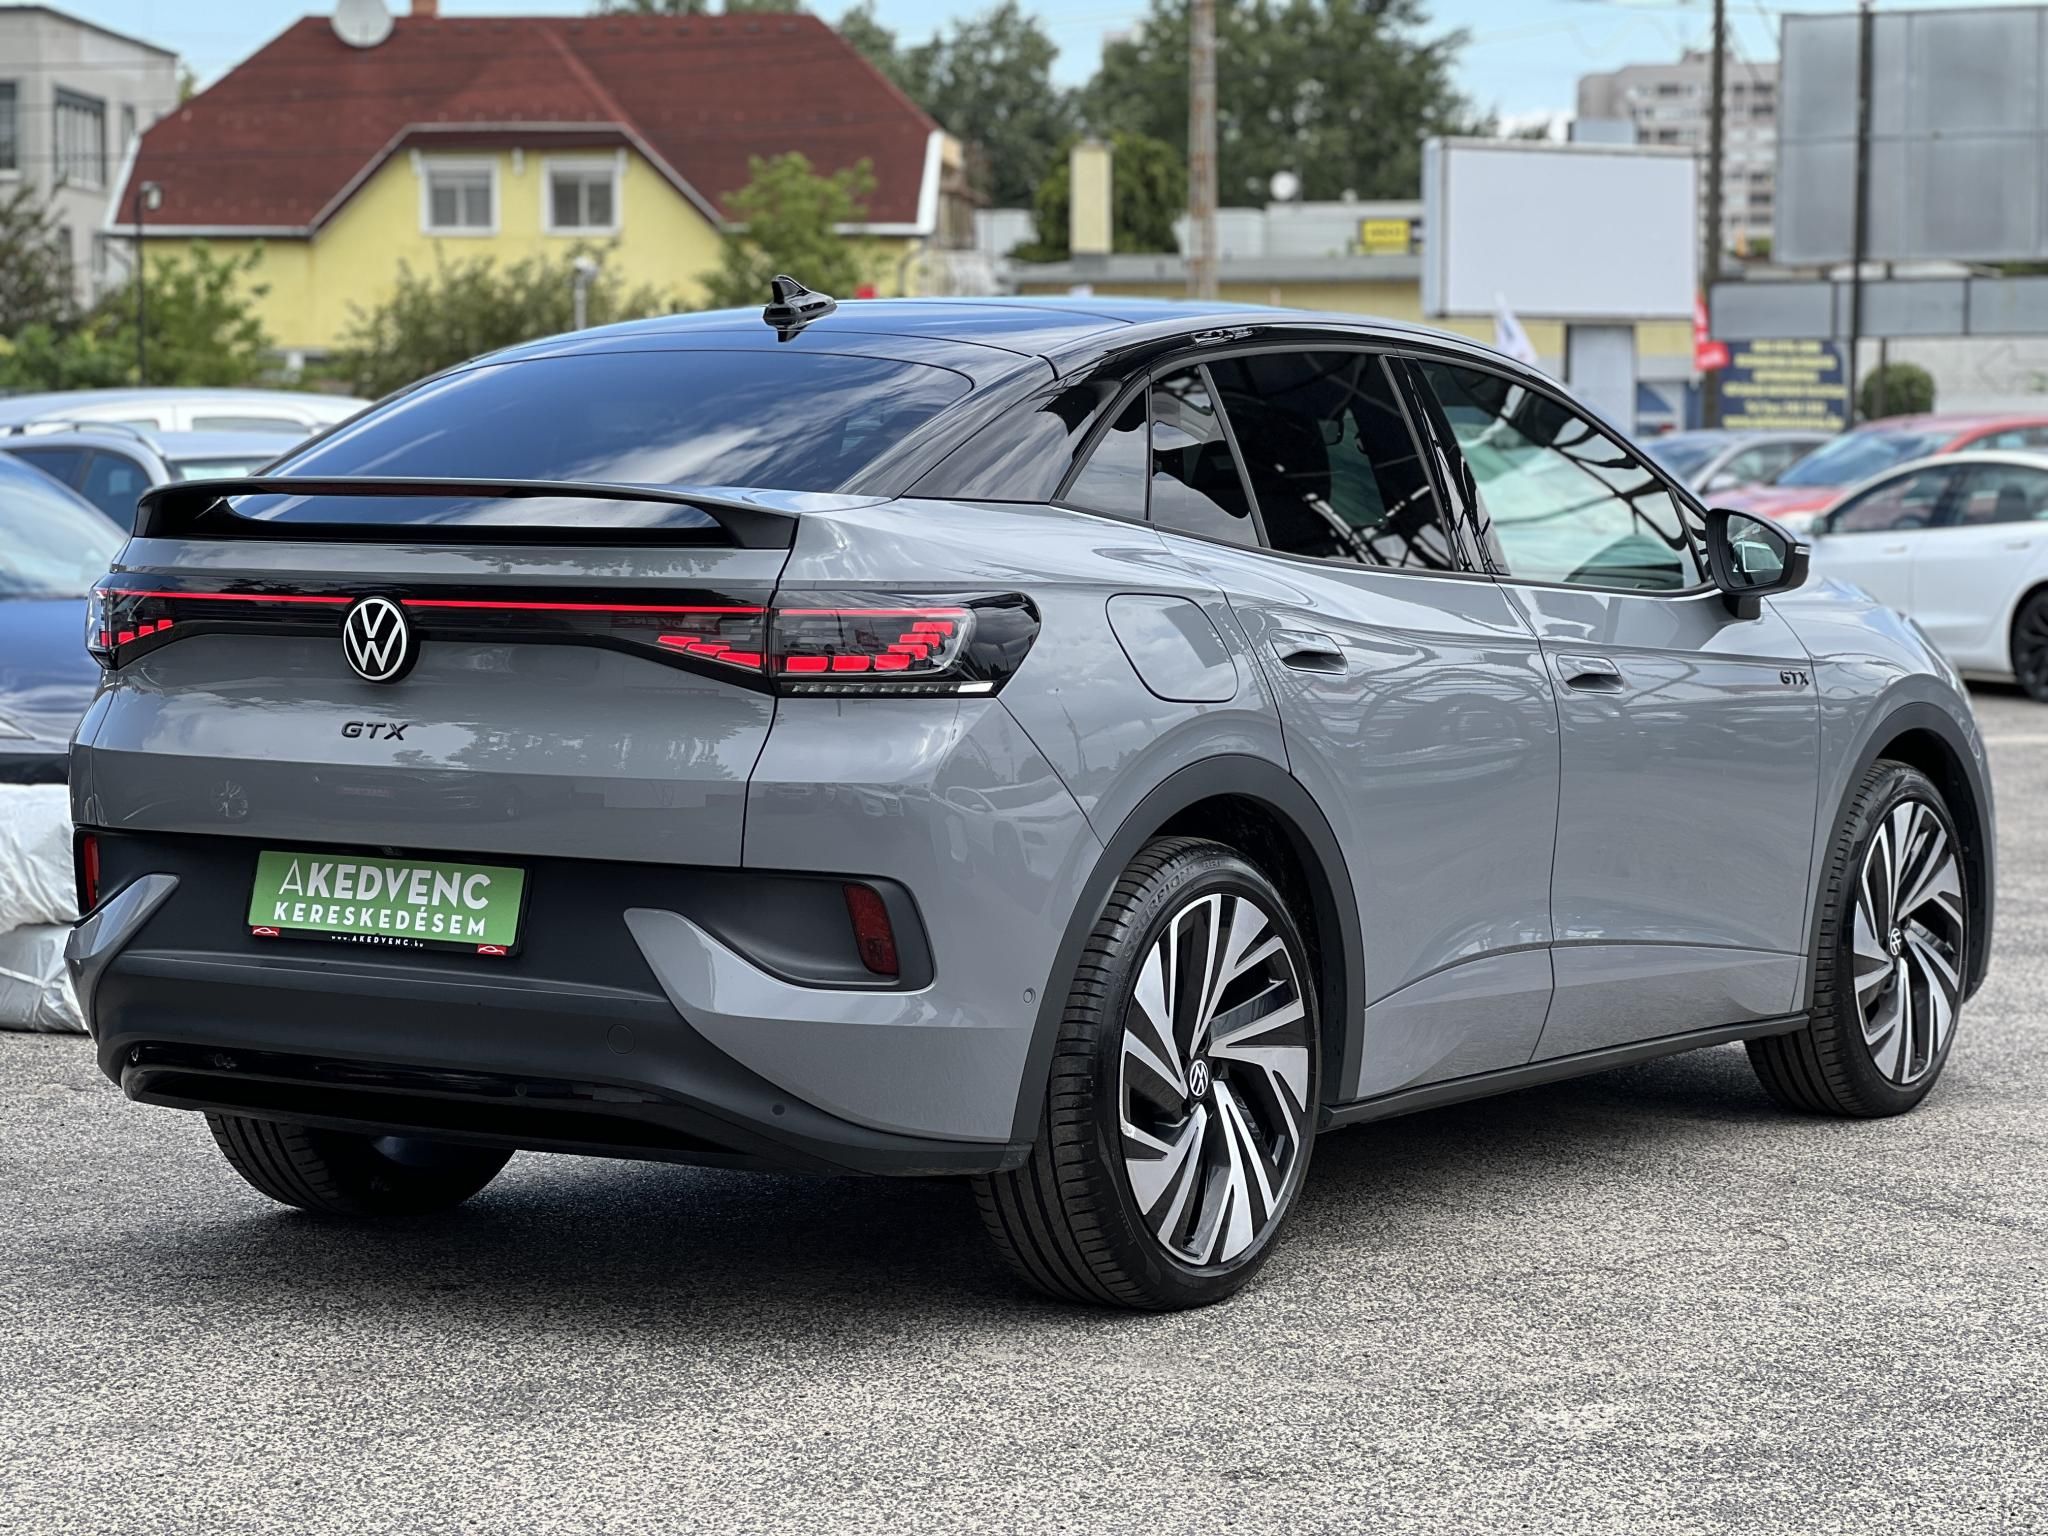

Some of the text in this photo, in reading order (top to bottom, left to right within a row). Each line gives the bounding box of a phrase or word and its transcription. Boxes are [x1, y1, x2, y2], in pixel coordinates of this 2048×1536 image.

[1780, 671, 1809, 685] GTX
[341, 721, 408, 740] GTX
[278, 858, 491, 910] AKEDVENC
[273, 901, 486, 937] KERESKEDÉSEM
